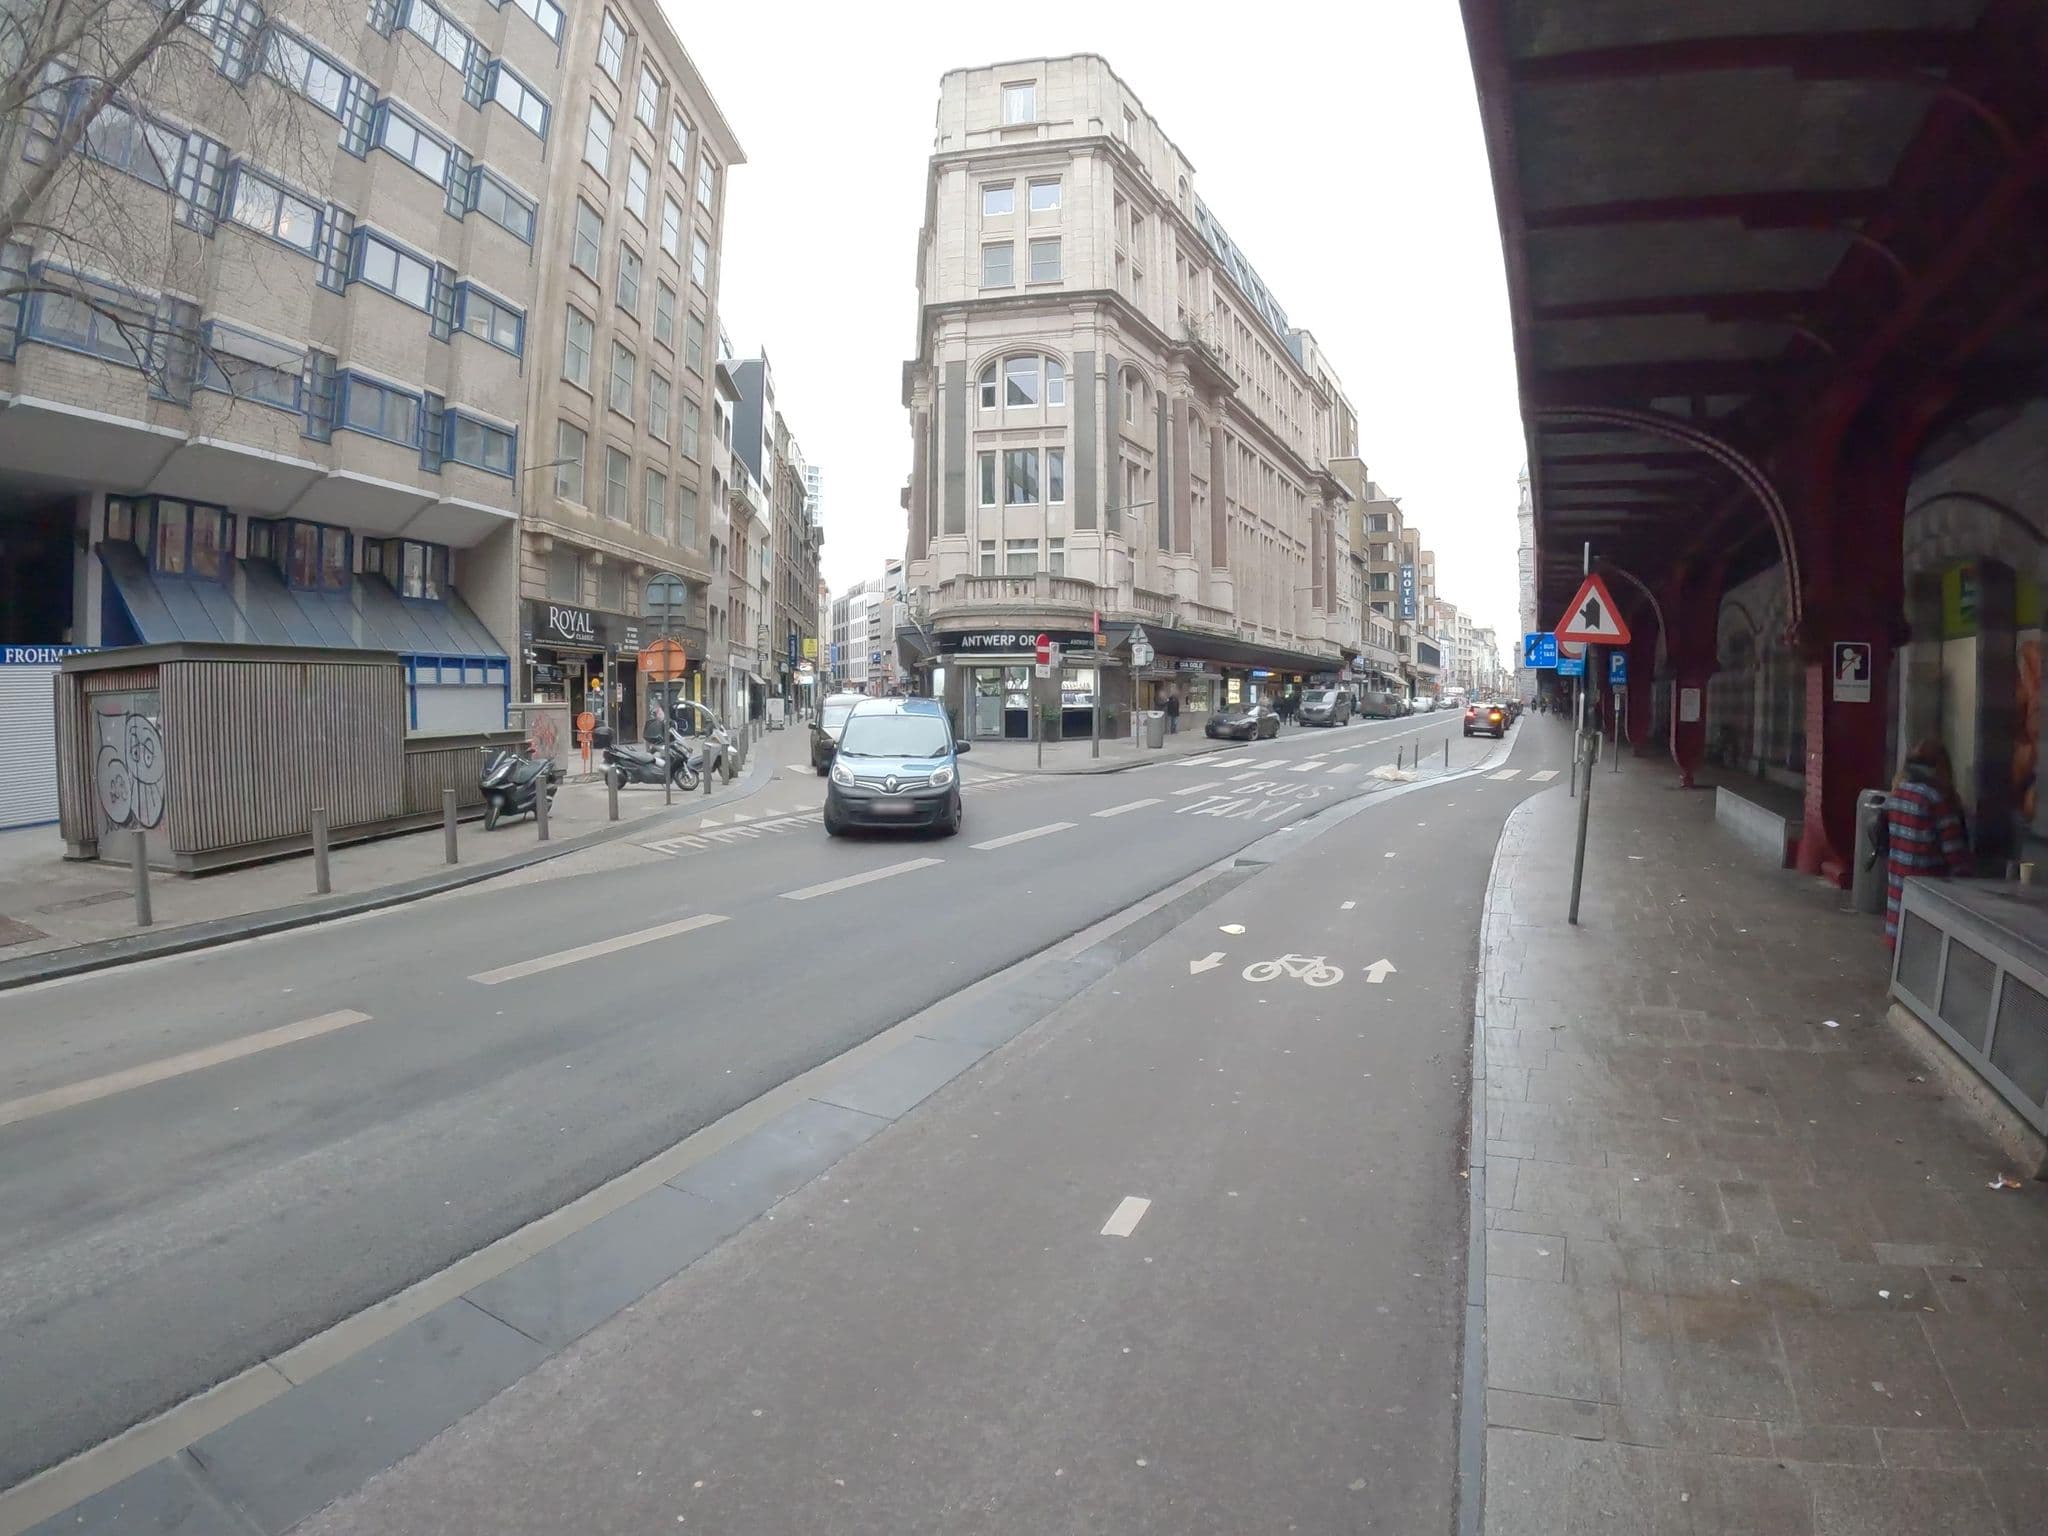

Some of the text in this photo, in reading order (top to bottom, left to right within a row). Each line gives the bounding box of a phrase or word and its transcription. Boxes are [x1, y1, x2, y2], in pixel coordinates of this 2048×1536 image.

[1403, 570, 1412, 615] HOTEL
[549, 606, 594, 639] ROYAL
[961, 635, 1016, 647] ANTWERP
[5, 648, 100, 663] FROHM
[1612, 655, 1624, 673] P
[1229, 781, 1335, 799] BUS
[1173, 795, 1304, 822] TAXI
